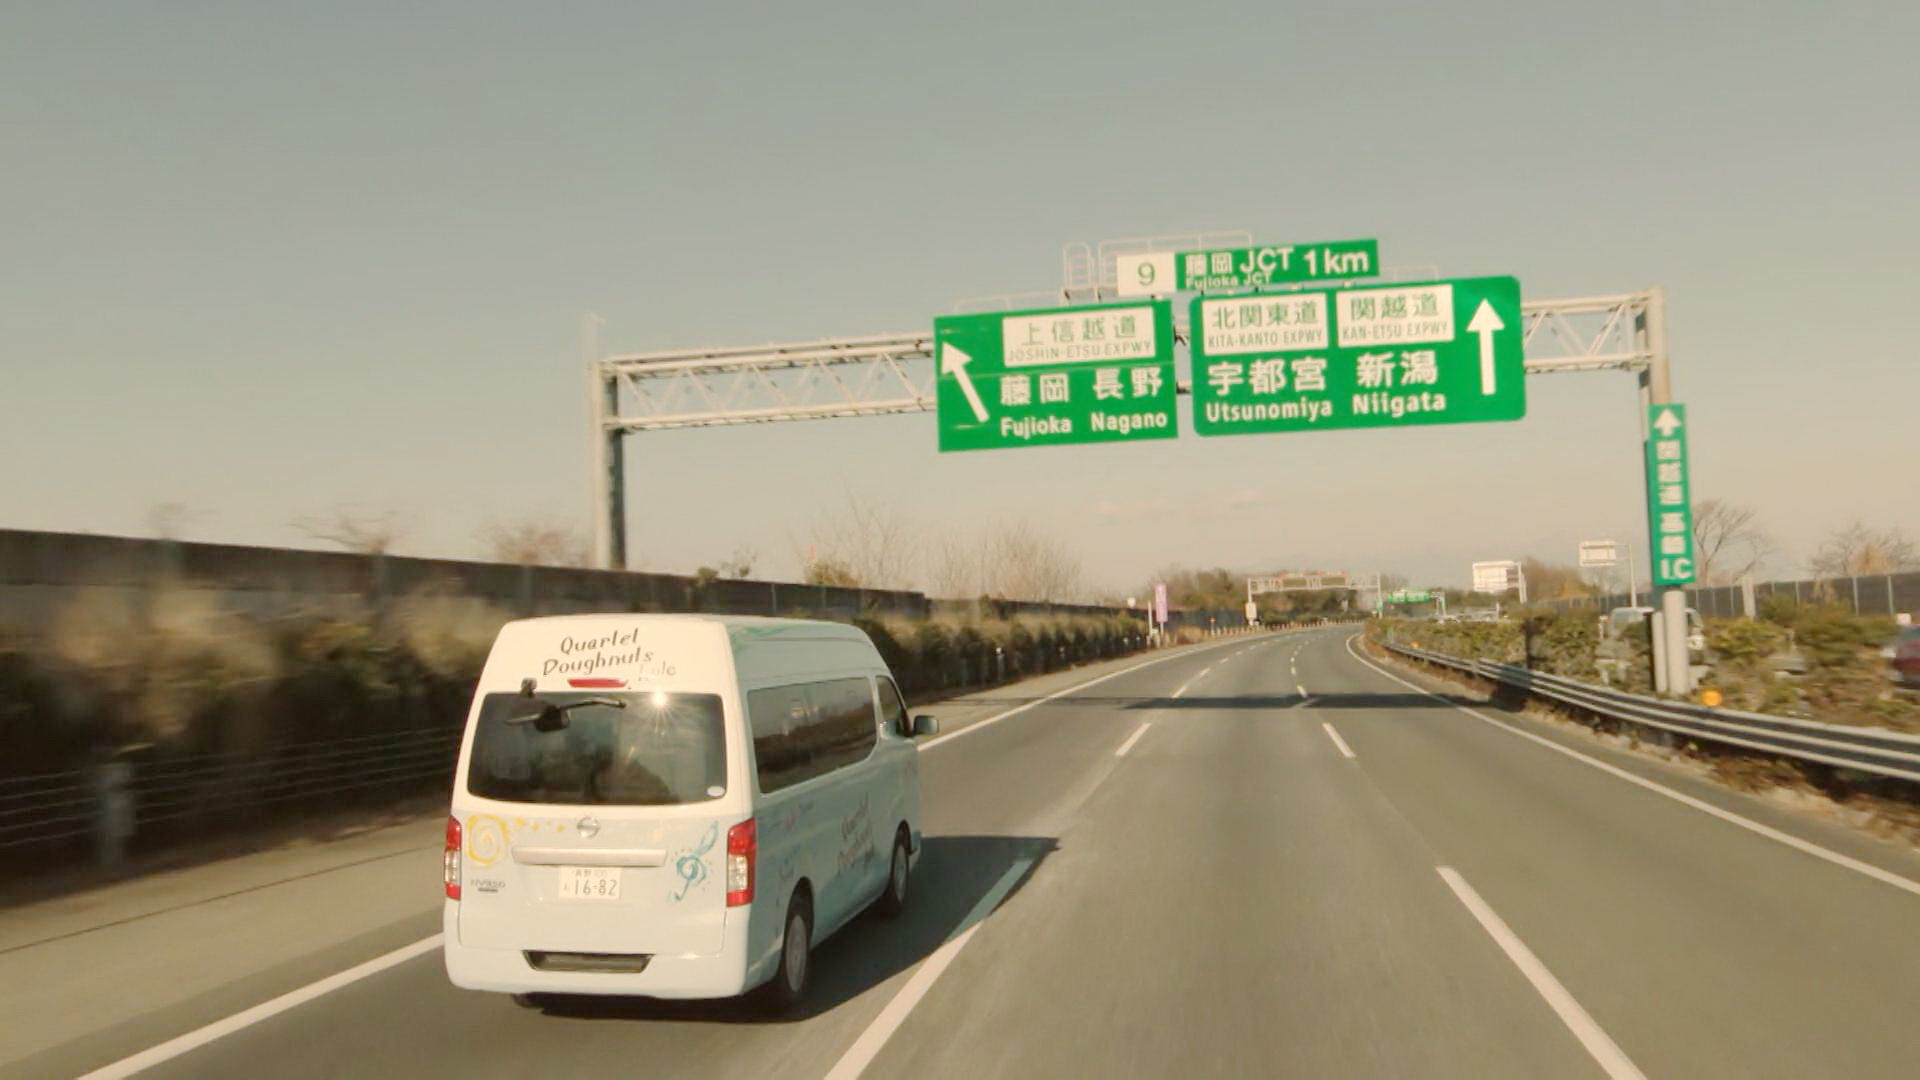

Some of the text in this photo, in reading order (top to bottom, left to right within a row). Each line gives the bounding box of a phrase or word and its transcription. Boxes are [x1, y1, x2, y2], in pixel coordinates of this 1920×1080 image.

[1239, 247, 1294, 273] JCT
[1137, 262, 1155, 287] 9
[1185, 271, 1273, 290] Fujioka JCT
[1211, 301, 1318, 330] 北関東道
[1350, 293, 1439, 321] 関越道
[1020, 315, 1137, 346] 上信越道
[1283, 329, 1323, 345] EXPWY
[1406, 321, 1448, 338] EXPWY
[1104, 340, 1151, 357] EXPWY
[1000, 366, 1163, 406] 藤岡 長野
[1207, 350, 1438, 396] 宇都宮 新潟
[1205, 392, 1446, 423] Utsunomiya Niigata
[1000, 411, 1168, 440] Fujioka Nagano
